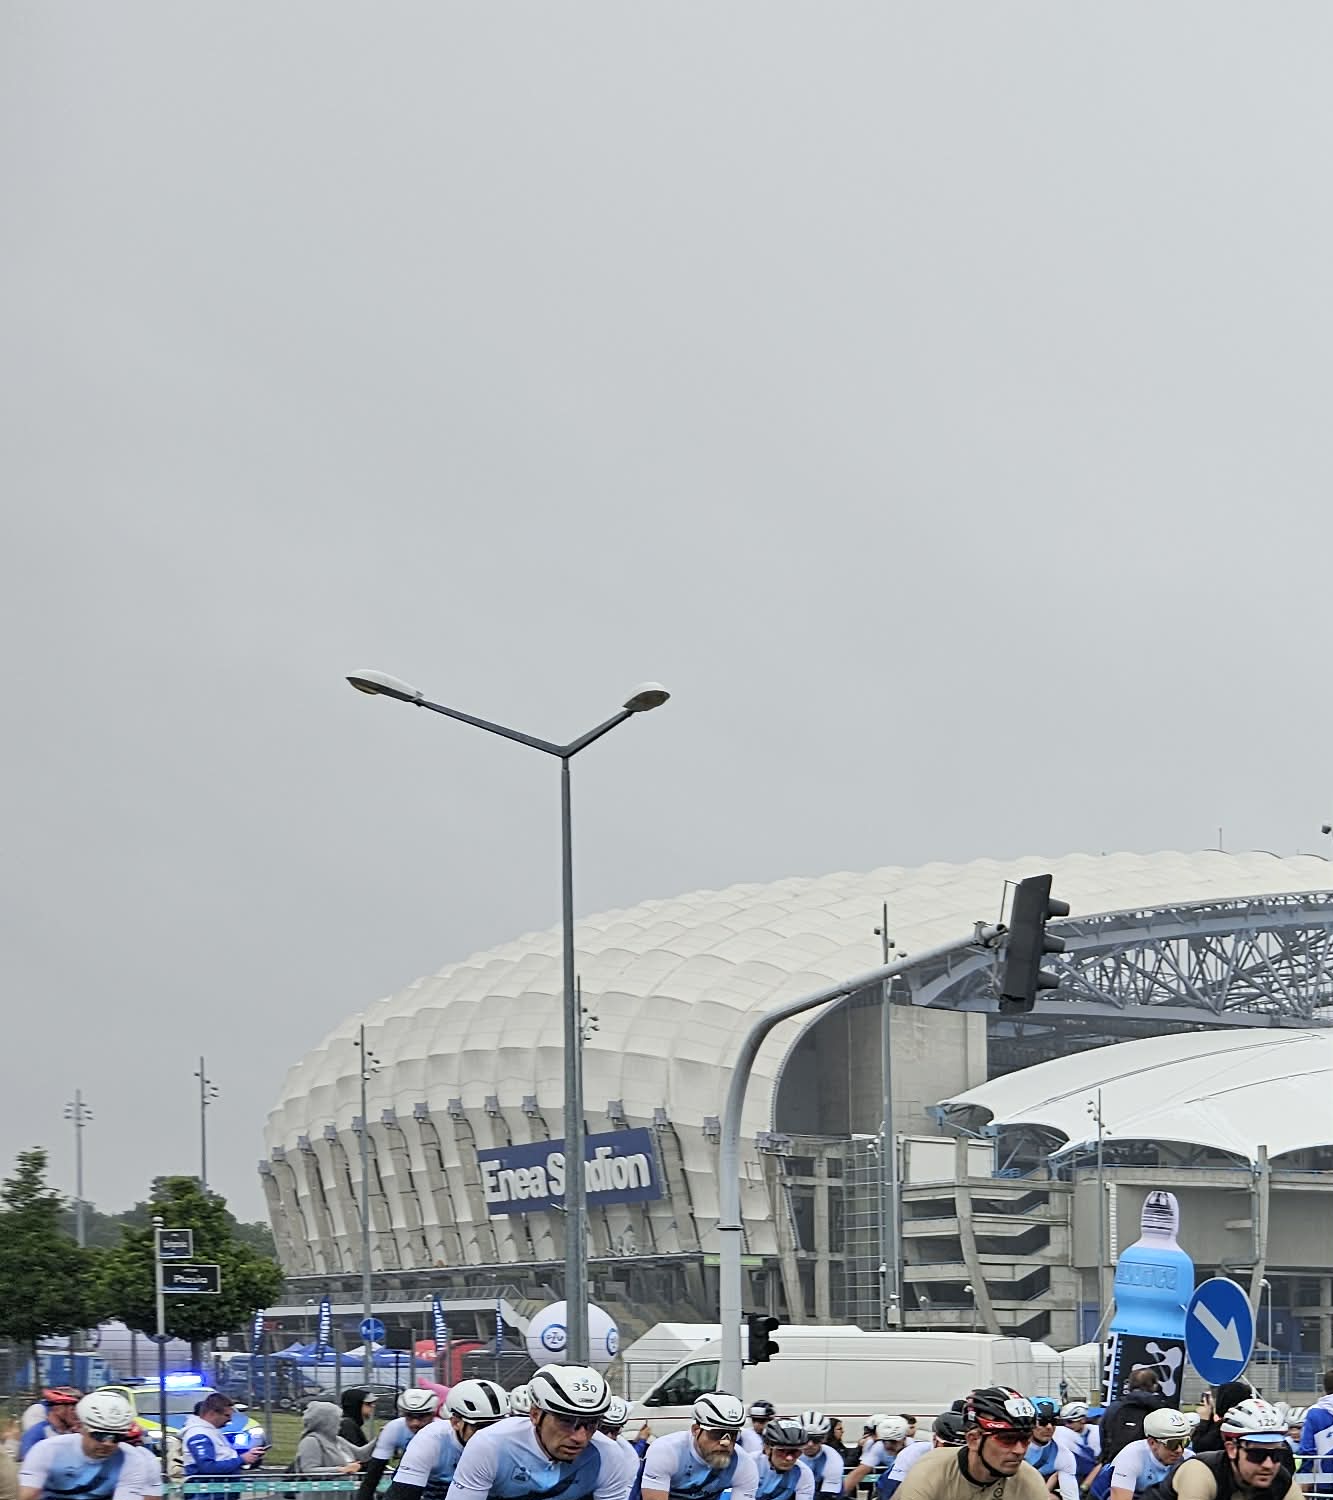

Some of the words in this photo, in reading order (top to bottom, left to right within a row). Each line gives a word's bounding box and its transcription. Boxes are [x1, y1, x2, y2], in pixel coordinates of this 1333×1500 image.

[480, 1160, 549, 1203] Enea
[546, 1147, 651, 1196] Sdion
[573, 1382, 598, 1394] 350
